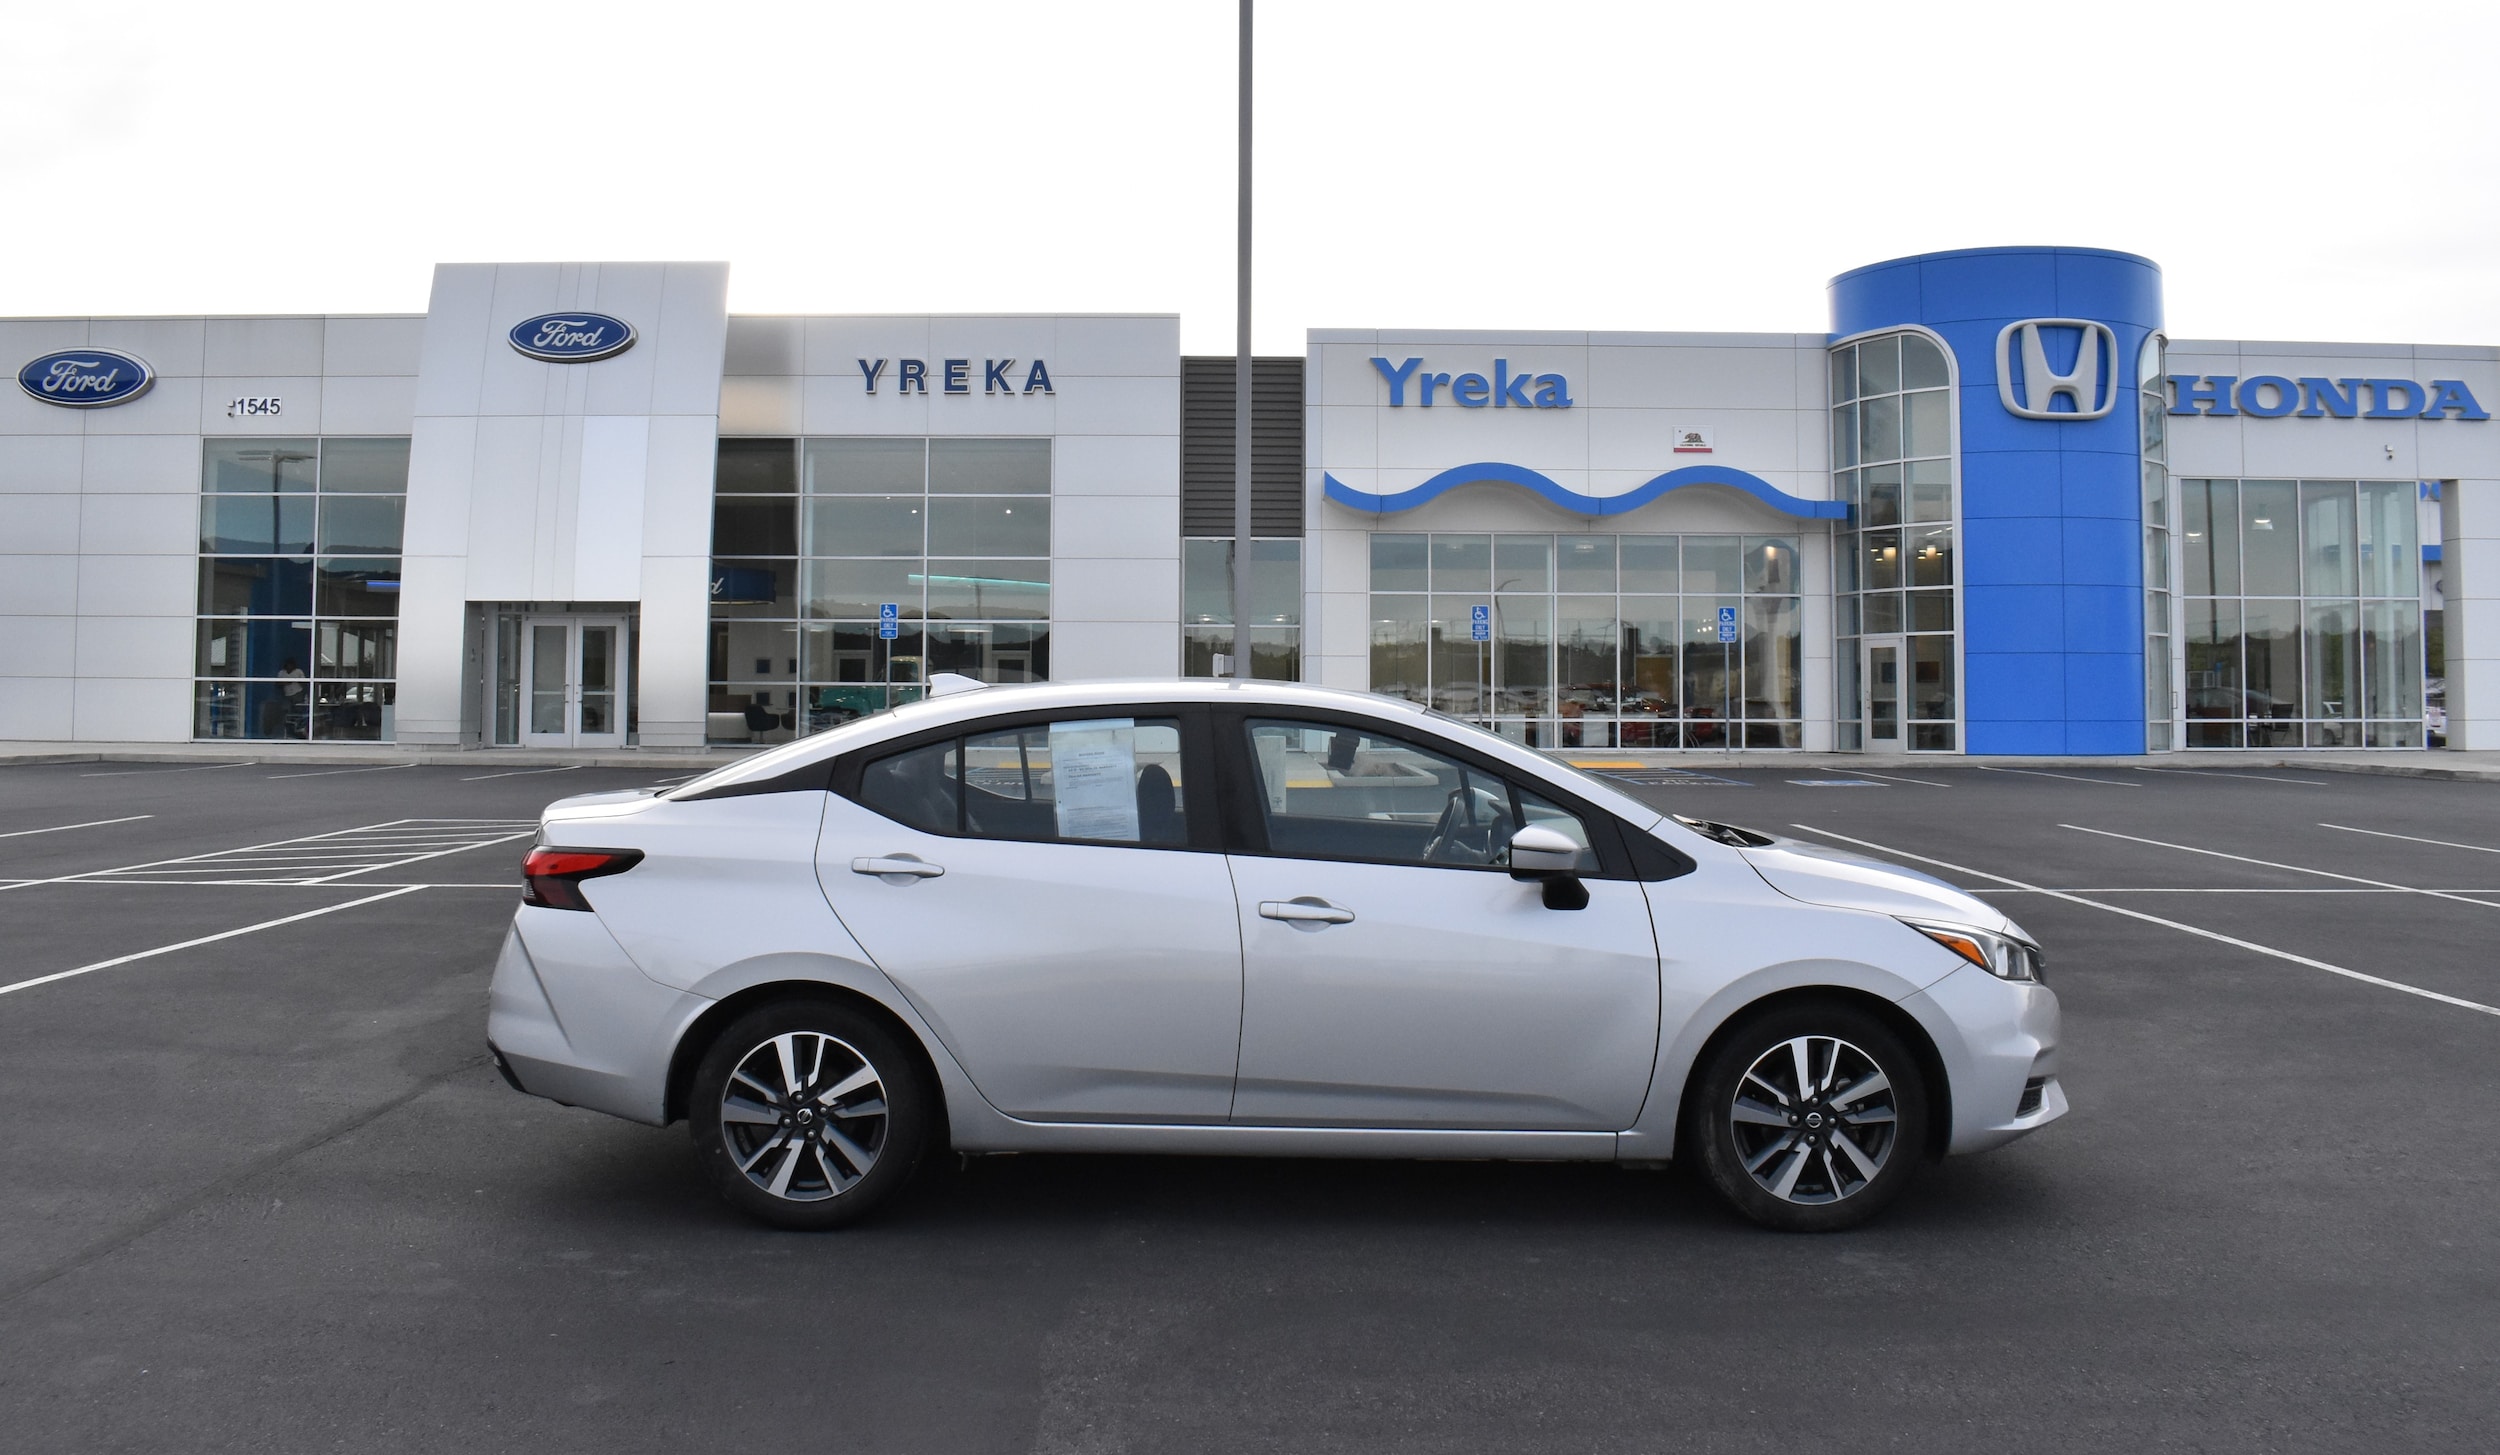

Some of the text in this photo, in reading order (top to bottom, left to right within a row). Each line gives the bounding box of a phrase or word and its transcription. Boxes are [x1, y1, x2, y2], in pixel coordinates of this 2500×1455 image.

[533, 320, 605, 347] Ford
[42, 360, 118, 393] Ford
[857, 358, 1055, 394] YREKA
[1369, 357, 1573, 408] Yreka
[236, 398, 281, 415] 1545
[2166, 374, 2491, 420] HONDA
